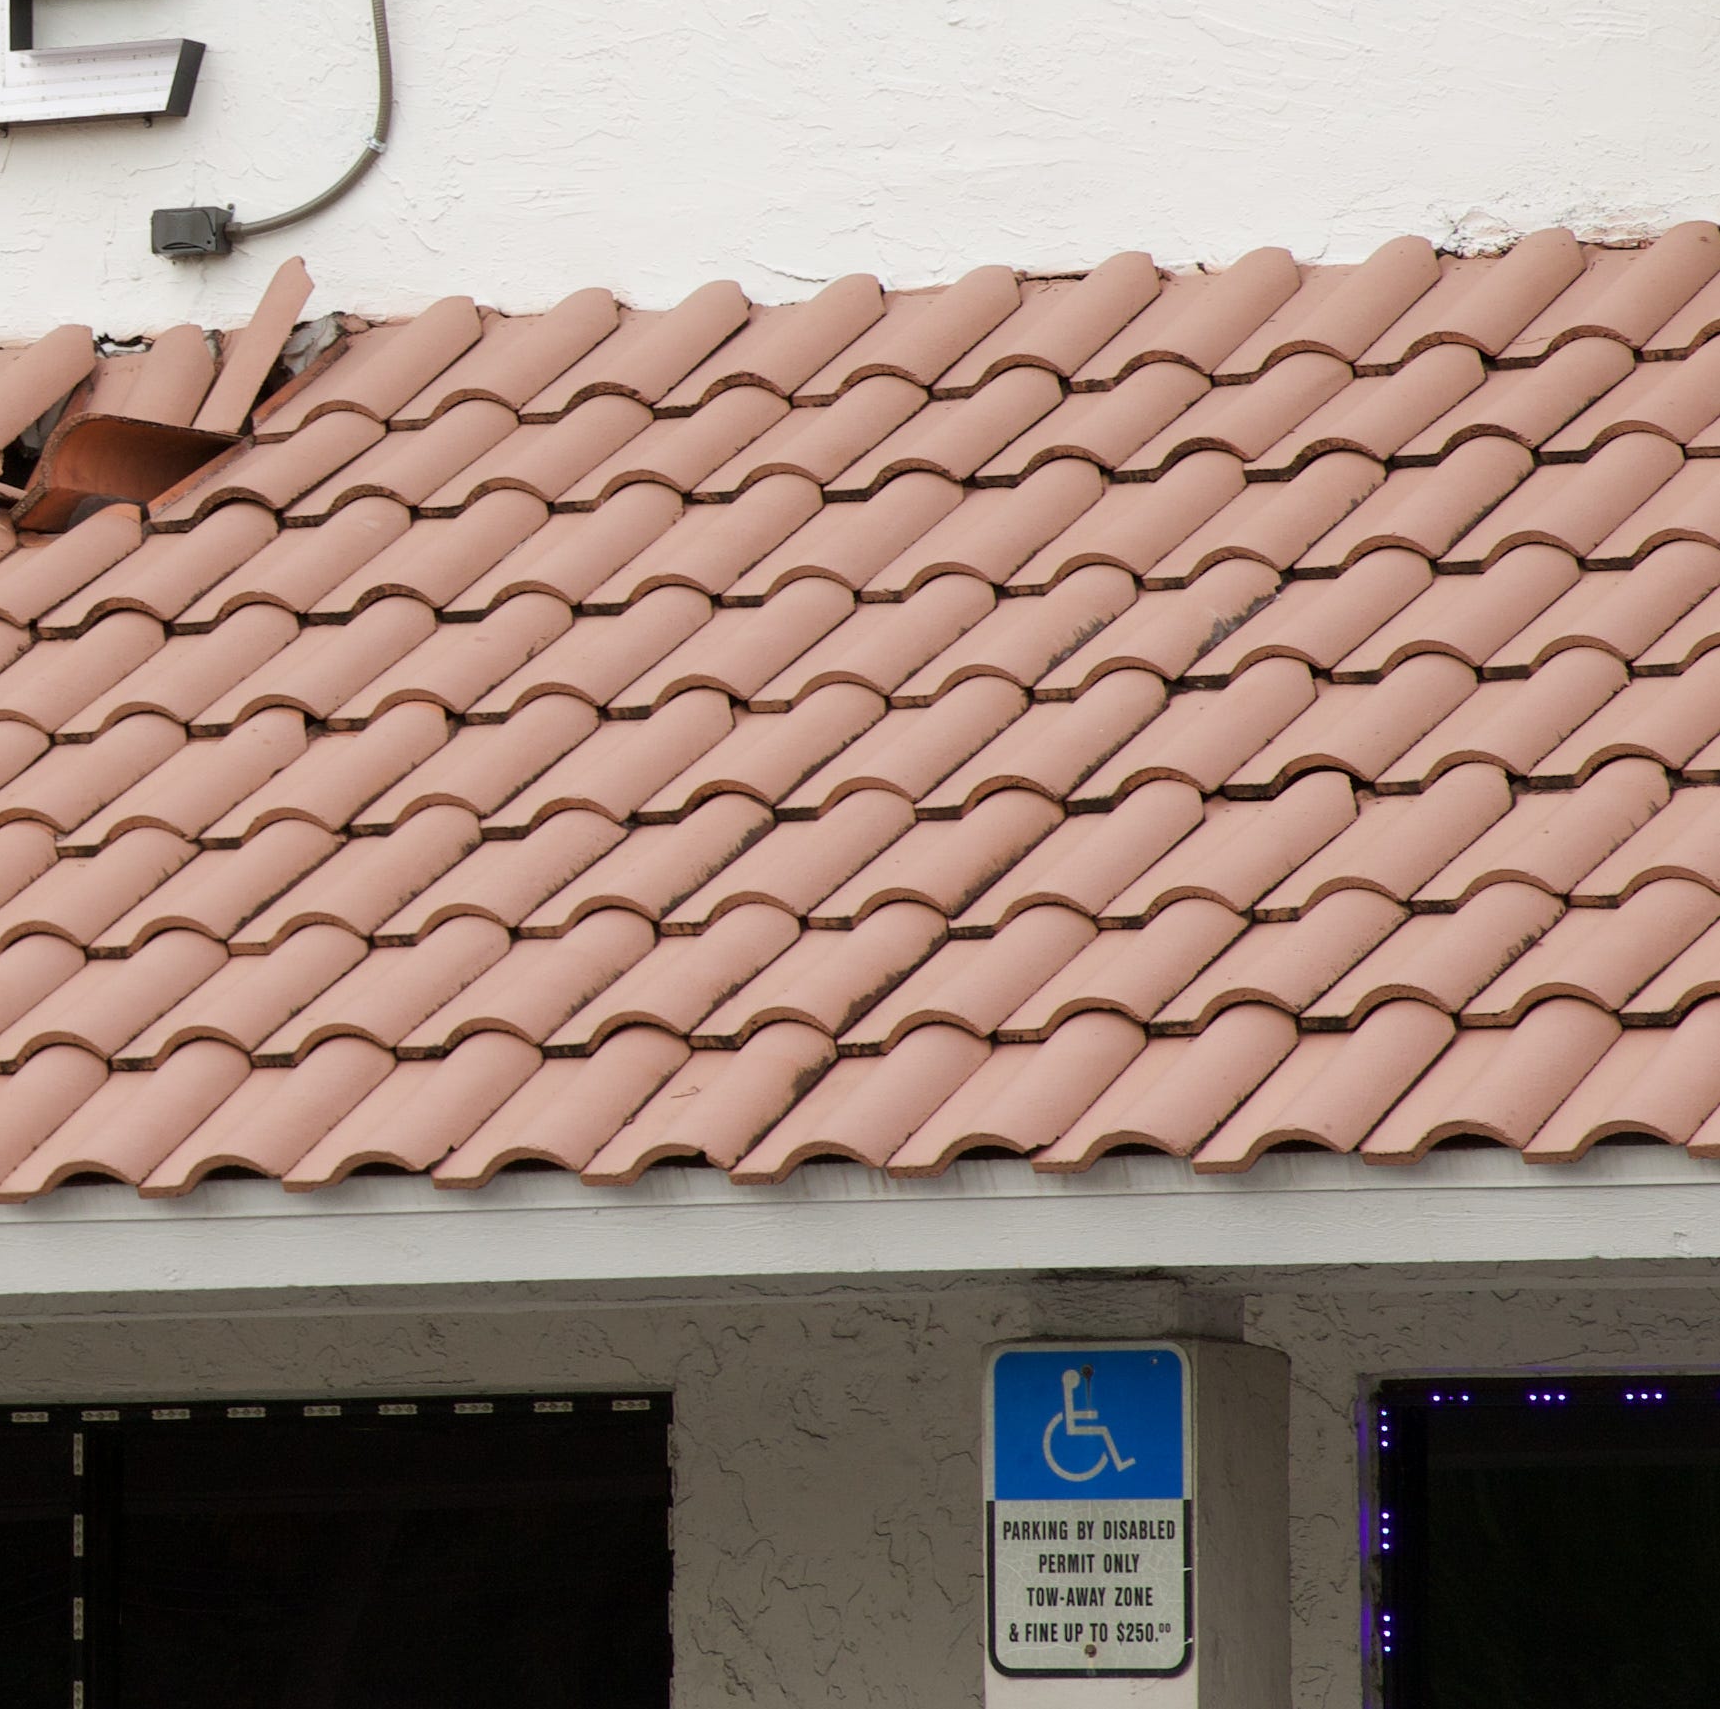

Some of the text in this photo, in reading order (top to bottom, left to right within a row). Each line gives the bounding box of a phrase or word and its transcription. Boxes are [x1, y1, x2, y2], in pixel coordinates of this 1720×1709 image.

[1002, 1519, 1176, 1541] PARKING BY DISABLED
[1038, 1553, 1140, 1574] PERMIT ONLY
[1026, 1586, 1154, 1607] TOW-AWAY ZONE
[1008, 1622, 1019, 1642] &
[1025, 1622, 1059, 1642] FINE
[1064, 1622, 1084, 1642] UP
[1089, 1622, 1109, 1642] TO
